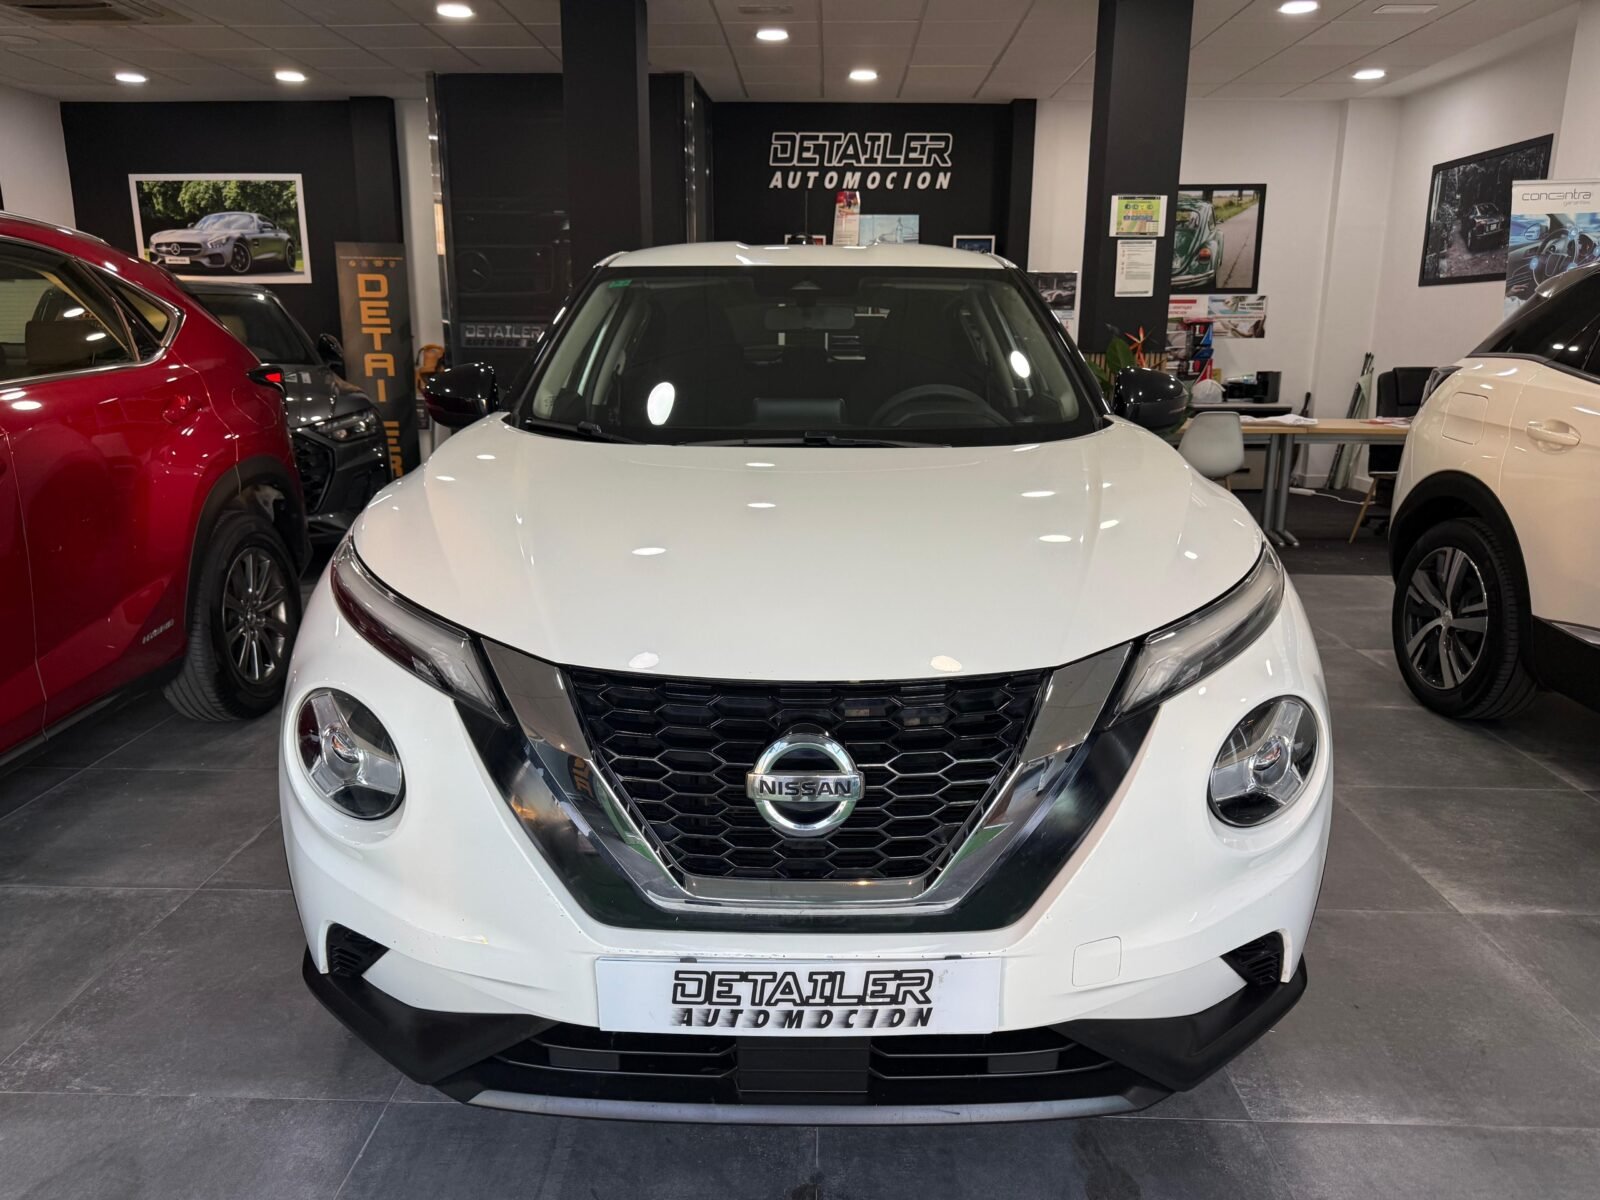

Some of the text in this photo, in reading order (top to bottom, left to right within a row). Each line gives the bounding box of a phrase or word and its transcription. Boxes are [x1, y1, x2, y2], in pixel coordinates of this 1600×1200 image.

[769, 132, 952, 167] DETAILER
[769, 171, 952, 190] AUTOMOCION
[759, 779, 851, 796] NISSAN
[672, 969, 934, 1006] DETAILER
[672, 1007, 933, 1029] AUTOMOCION
